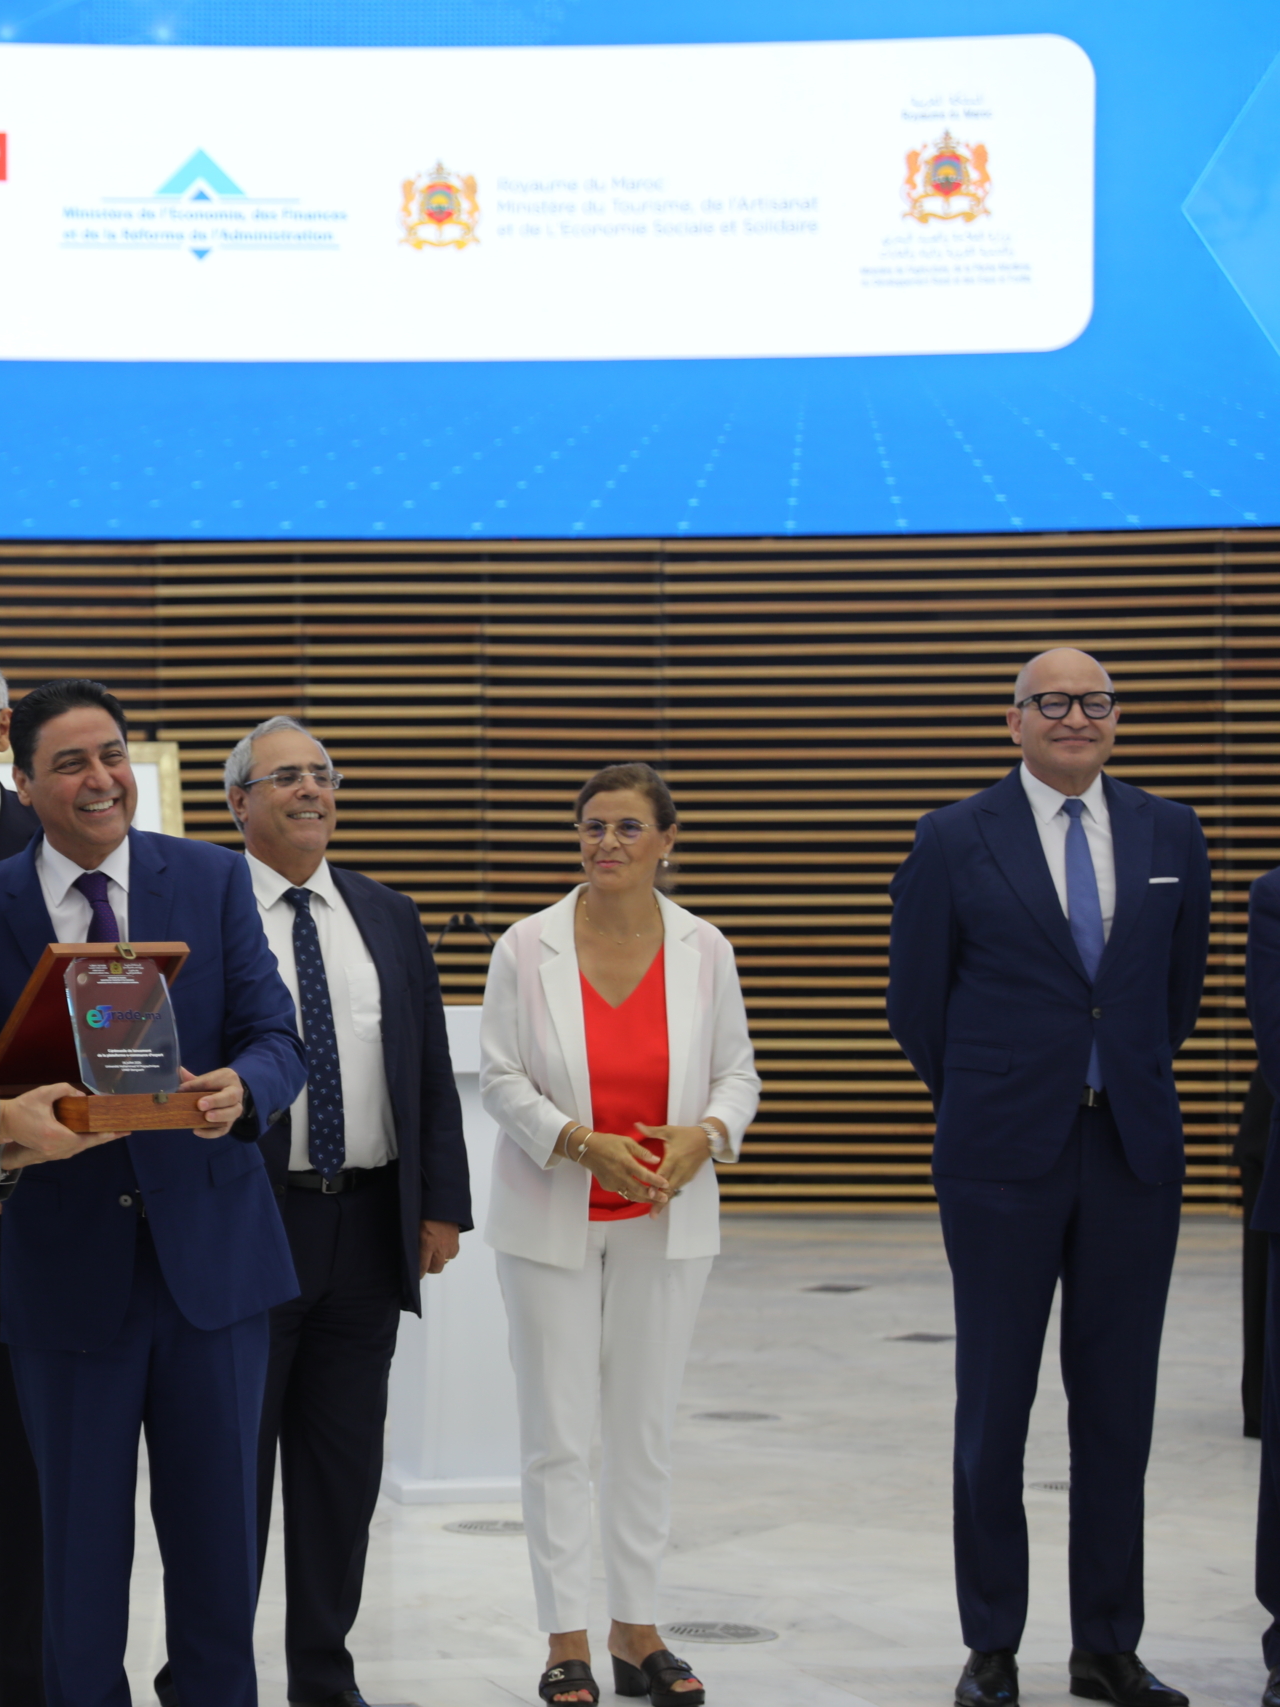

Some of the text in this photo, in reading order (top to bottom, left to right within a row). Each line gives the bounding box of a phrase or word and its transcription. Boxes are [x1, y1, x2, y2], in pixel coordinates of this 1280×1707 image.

[496, 176, 666, 195] Royaume du Maroc
[581, 198, 606, 215] du
[700, 197, 723, 214] de
[496, 221, 515, 238] et
[518, 221, 541, 238] de
[653, 220, 714, 237] Sociale
[719, 219, 739, 236] et
[742, 217, 819, 236] Solidaire
